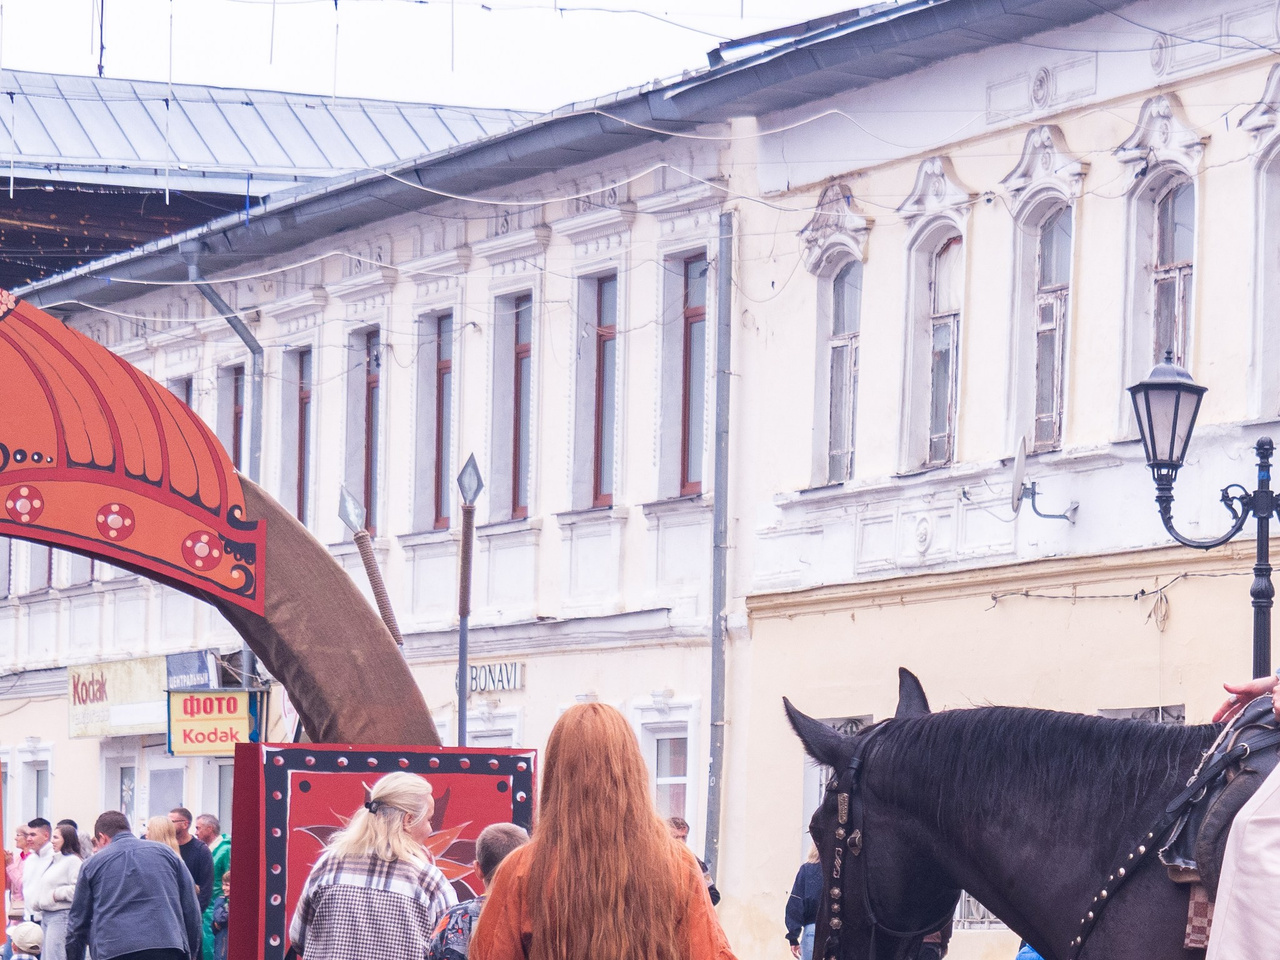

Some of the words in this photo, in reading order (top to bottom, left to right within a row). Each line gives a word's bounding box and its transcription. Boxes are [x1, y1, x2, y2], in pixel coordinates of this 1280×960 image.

[72, 671, 108, 706] Kodak
[470, 662, 517, 692] BONAVI
[183, 695, 239, 717] ФОТО
[183, 727, 240, 744] Kodak
